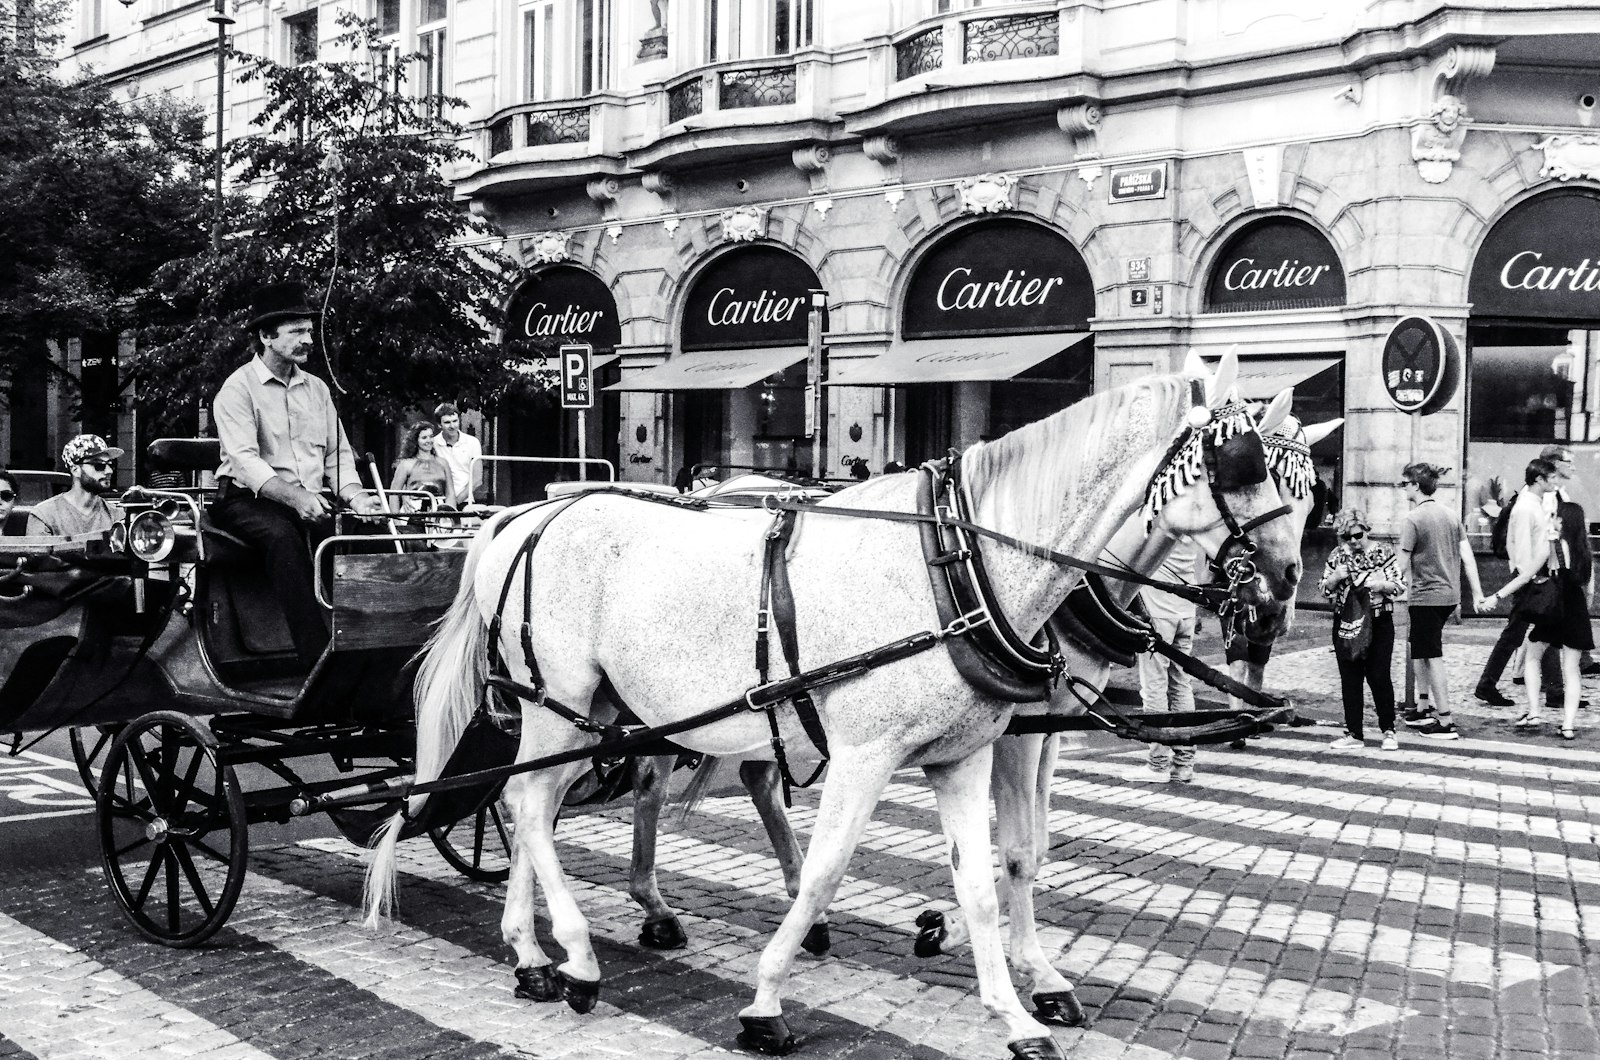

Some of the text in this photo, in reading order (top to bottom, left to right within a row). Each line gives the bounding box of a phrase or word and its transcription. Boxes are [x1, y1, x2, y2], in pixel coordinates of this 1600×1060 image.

[1130, 260, 1146, 271] 934
[1224, 257, 1330, 292] Cartier
[1499, 250, 1600, 292] Carti
[707, 287, 806, 326] Cartier
[937, 267, 1064, 311] Cartier
[1136, 291, 1142, 302] 2
[525, 302, 604, 337] Cartier
[566, 353, 585, 389] P
